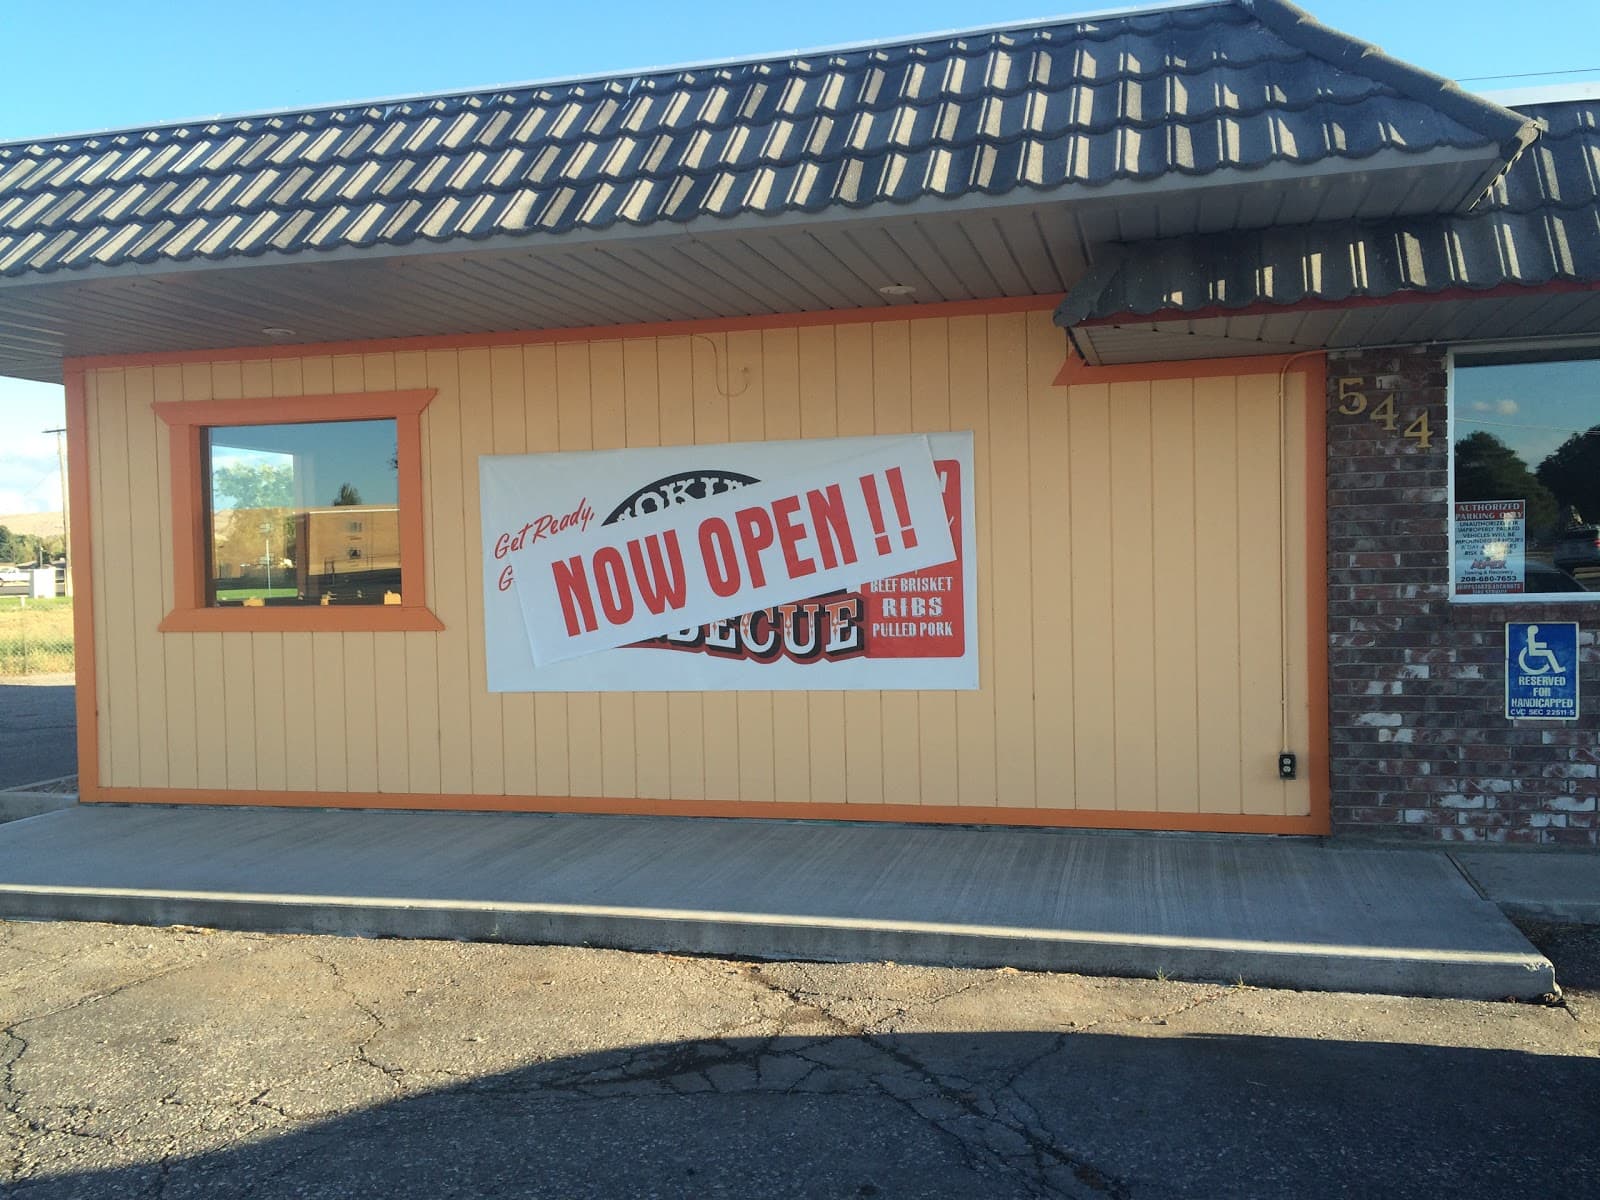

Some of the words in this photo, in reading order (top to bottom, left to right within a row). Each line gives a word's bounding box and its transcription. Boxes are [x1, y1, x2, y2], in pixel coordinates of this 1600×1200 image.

[1458, 503, 1520, 511] AUTHORIZED
[1456, 512, 1495, 520] PARKING
[494, 523, 533, 559] Get
[532, 496, 595, 544] Ready,
[551, 529, 687, 637] NOW
[698, 482, 858, 598] OPEN
[859, 465, 919, 556] !!
[870, 578, 899, 593] BEEF
[900, 576, 953, 592] BRISKET
[882, 596, 943, 618] RIBS
[872, 622, 917, 638] PULLED
[919, 621, 953, 637] PORK
[1518, 675, 1567, 686] RESERVED
[1532, 686, 1552, 697] FOR
[1511, 698, 1573, 708] HANDICAPPED
